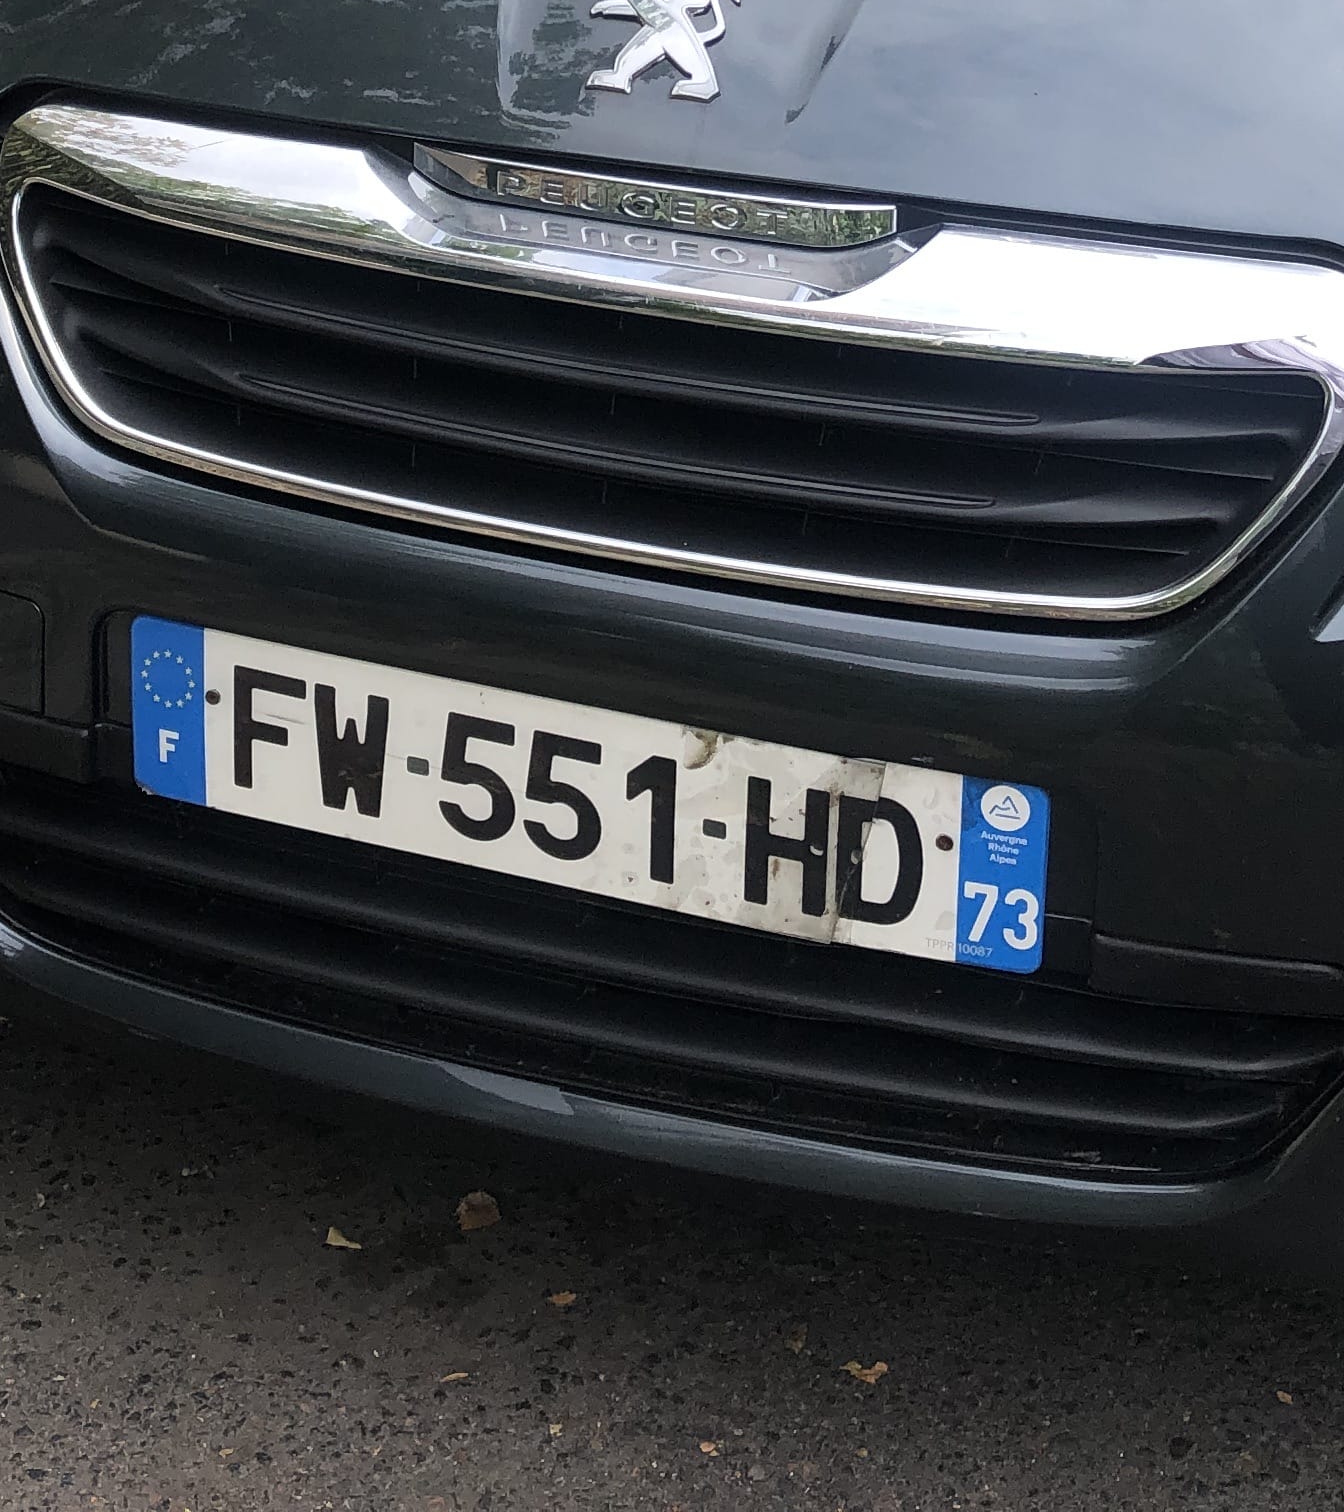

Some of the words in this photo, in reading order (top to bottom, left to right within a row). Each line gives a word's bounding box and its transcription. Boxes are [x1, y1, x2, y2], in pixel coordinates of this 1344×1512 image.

[497, 170, 788, 236] PEUGEOT
[158, 727, 180, 764] F
[981, 830, 1028, 846] Auvergne
[963, 880, 1040, 951] 73
